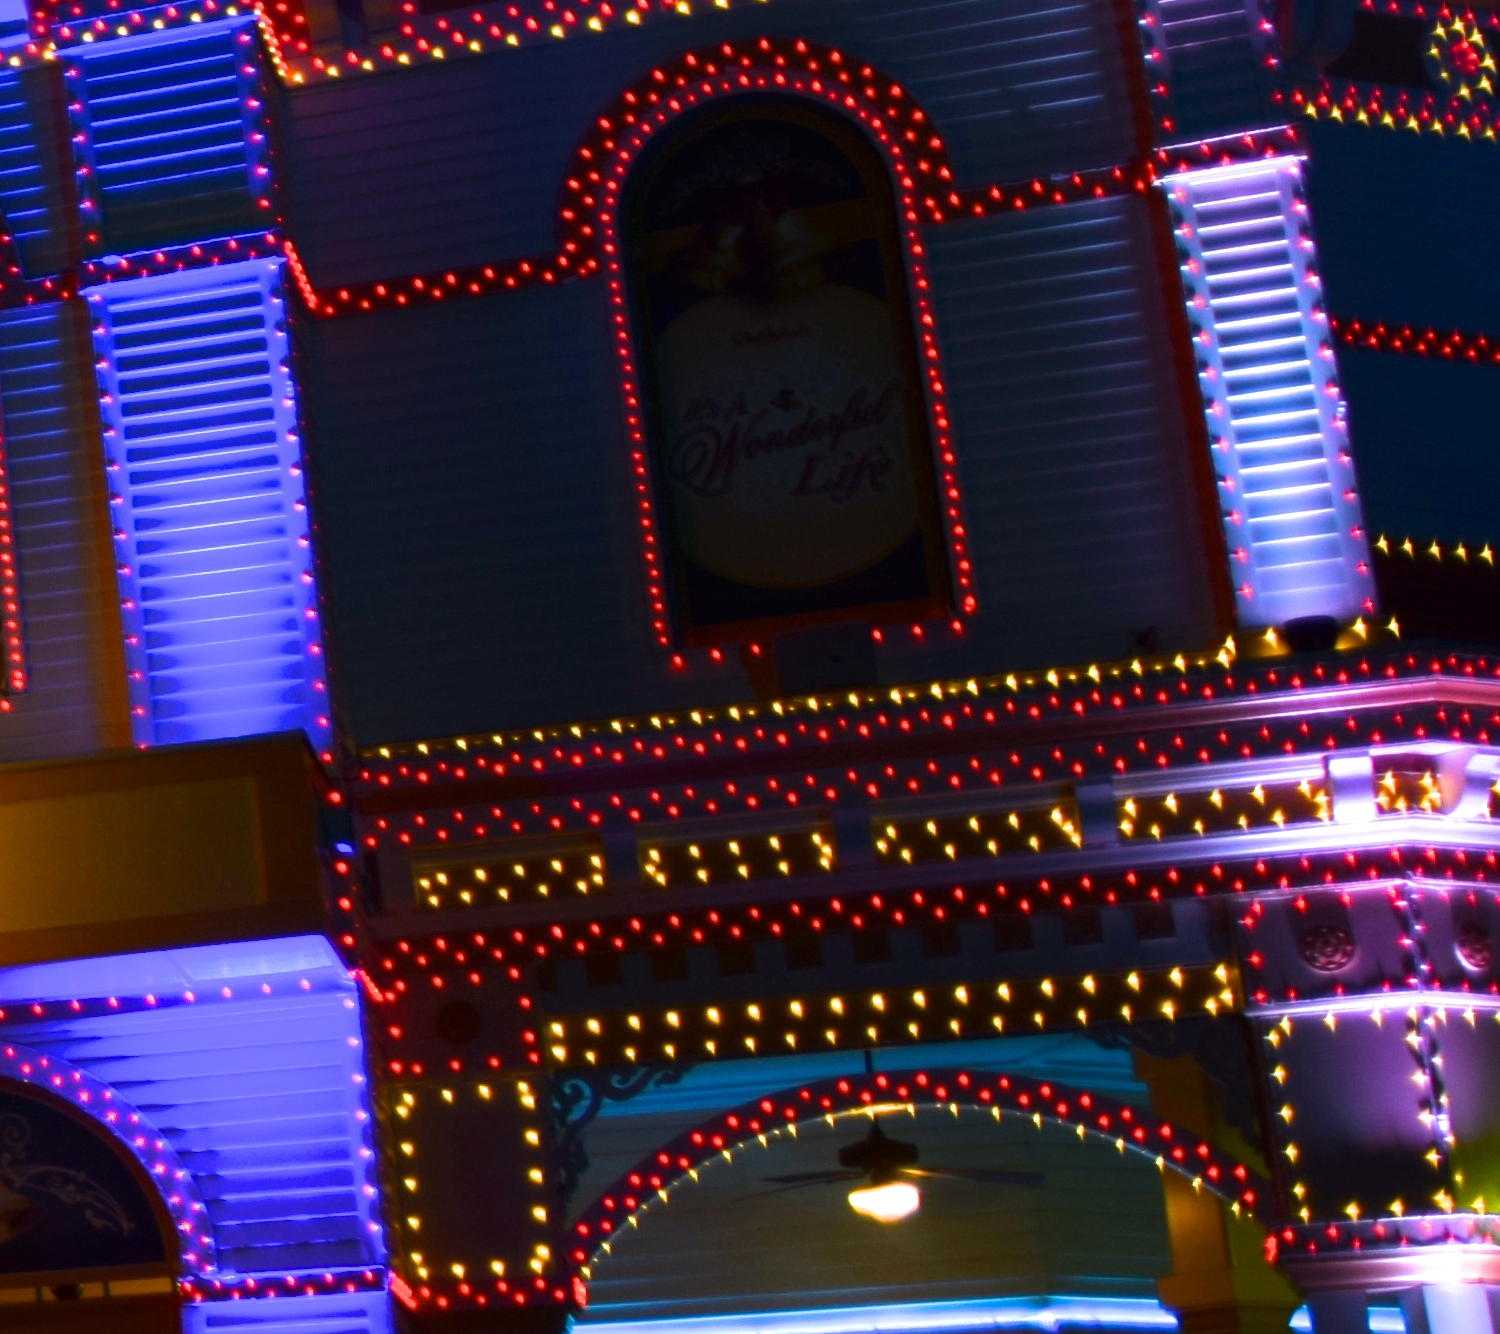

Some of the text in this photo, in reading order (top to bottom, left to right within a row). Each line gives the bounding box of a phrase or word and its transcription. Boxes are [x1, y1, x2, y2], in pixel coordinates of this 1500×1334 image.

[722, 392, 750, 422] A
[669, 377, 902, 498] Wonderful
[793, 445, 894, 504] Life
